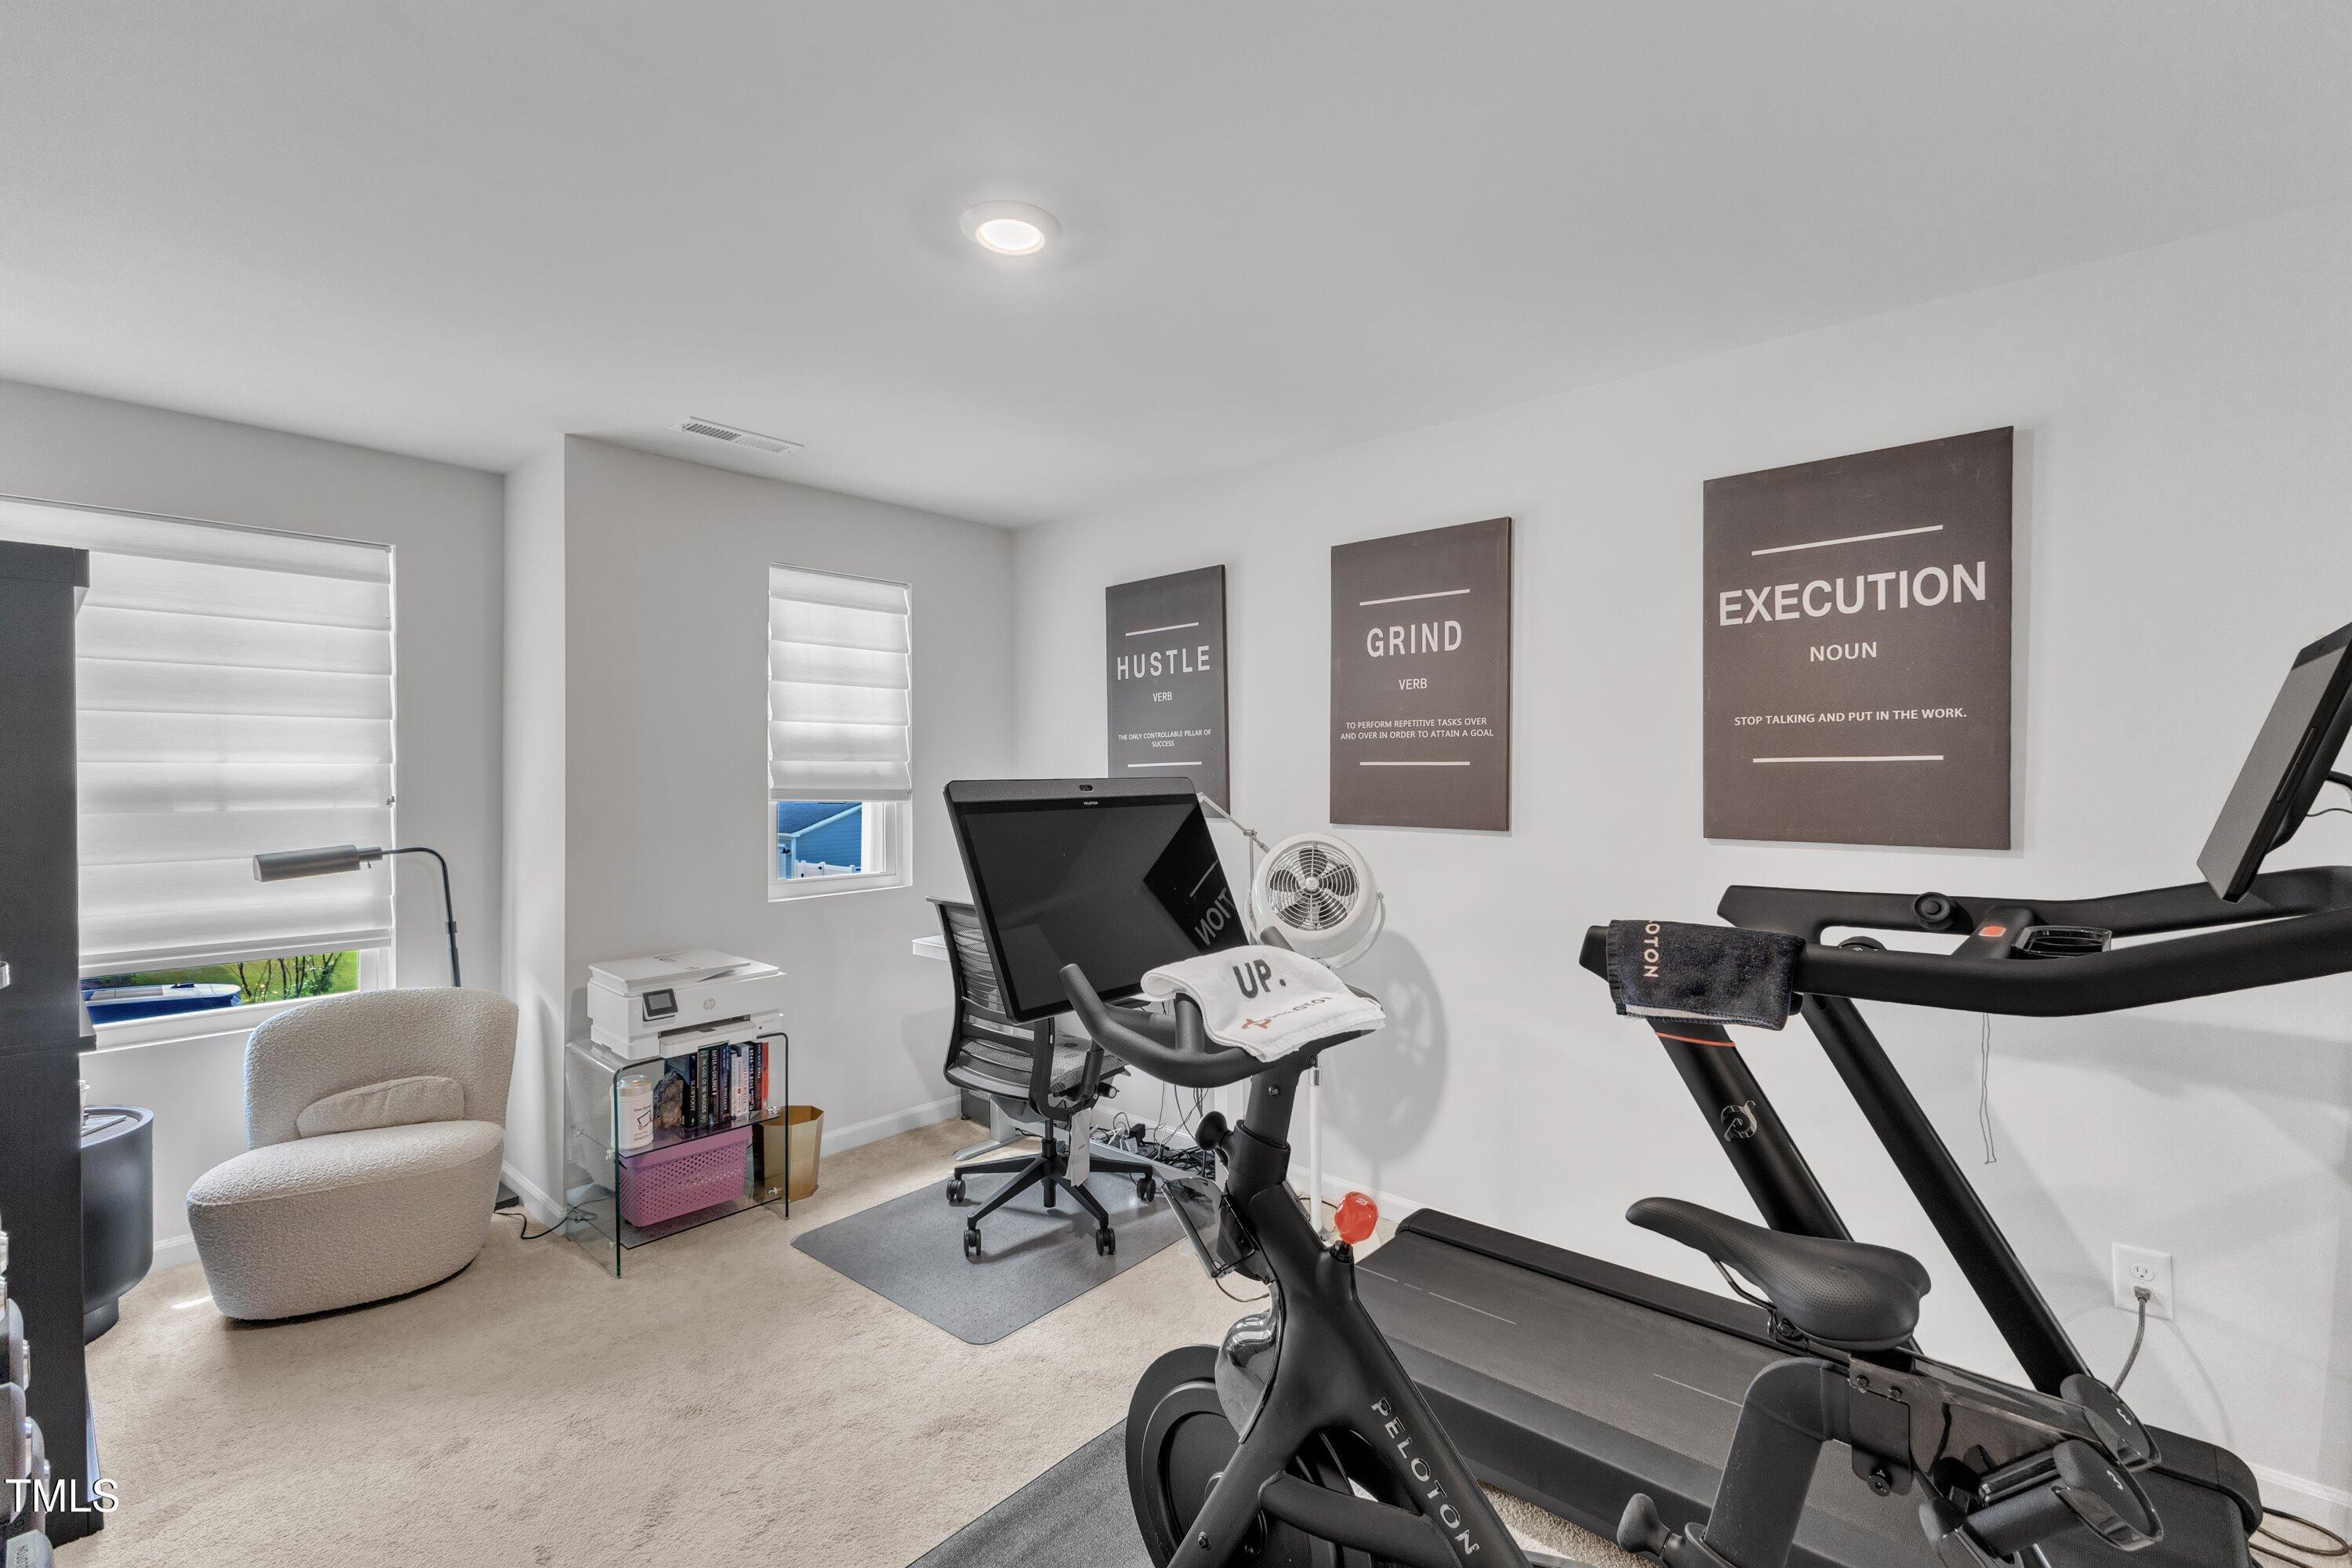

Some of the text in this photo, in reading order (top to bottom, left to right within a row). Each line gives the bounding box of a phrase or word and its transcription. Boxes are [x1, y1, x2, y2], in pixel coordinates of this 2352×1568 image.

[1720, 561, 1986, 626] EXECUTION
[1367, 620, 1462, 658] GRIND
[1810, 641, 1878, 662] NOUN
[1118, 645, 1210, 681] HUSTLE
[1153, 691, 1173, 702] VERB
[1399, 678, 1428, 691] VERB
[1358, 720, 1392, 729] PERFORM
[1395, 719, 1436, 728] REPETITIVE
[1438, 718, 1462, 727] TASKS
[1465, 717, 1487, 726] OVER
[1734, 708, 1967, 726] STOP TALKING AND PUT IN THE WORK.
[1144, 731, 1184, 739] CONTROLLABLE
[1643, 920, 1661, 978] OTON
[1232, 959, 1287, 999] UP.
[1371, 1397, 1480, 1555] PELOTON
